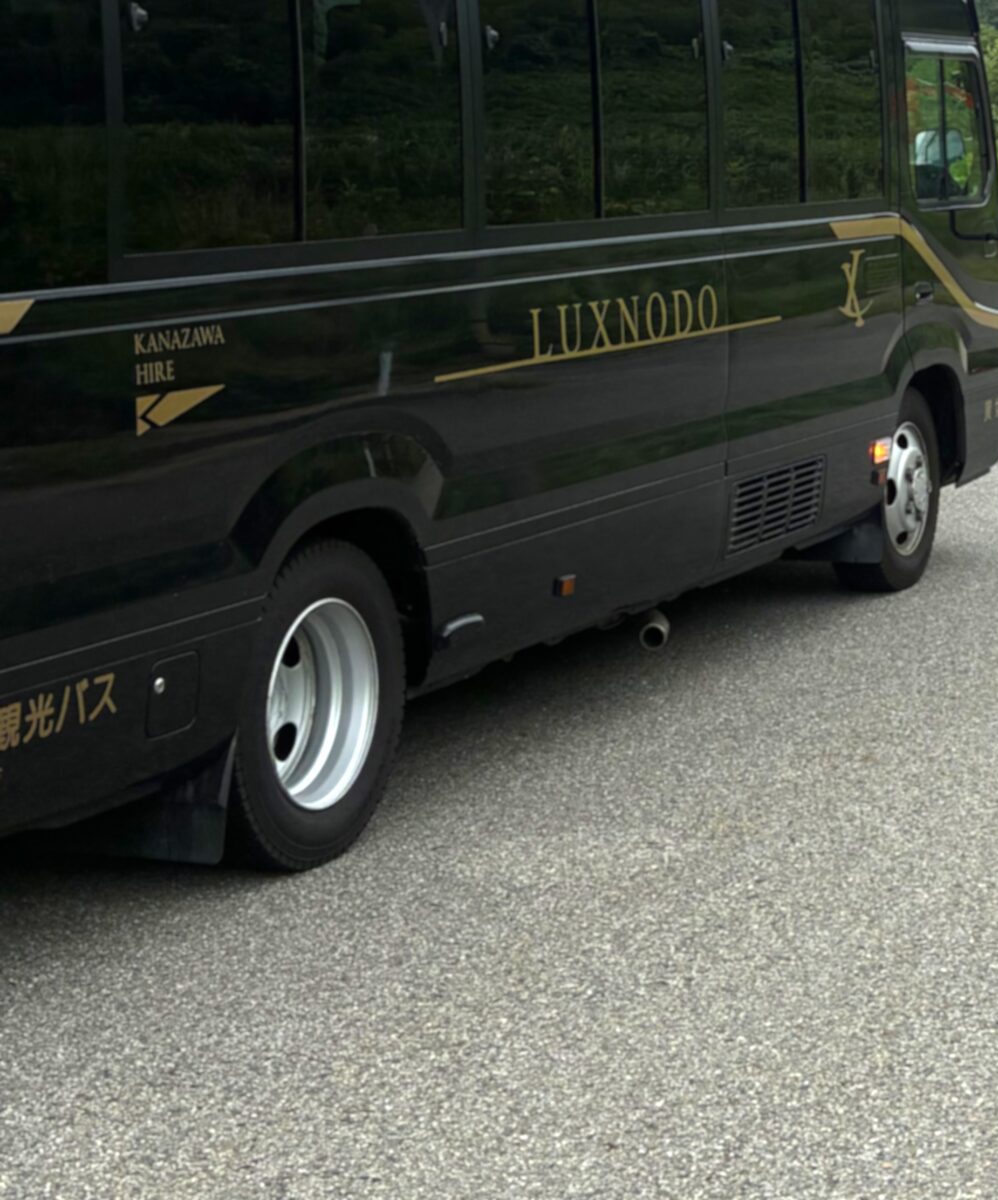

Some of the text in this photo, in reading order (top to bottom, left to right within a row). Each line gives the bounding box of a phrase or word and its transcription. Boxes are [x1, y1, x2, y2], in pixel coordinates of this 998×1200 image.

[529, 285, 718, 359] LUXNODO
[134, 324, 225, 355] KANAZAWA
[135, 360, 175, 385] HIRE
